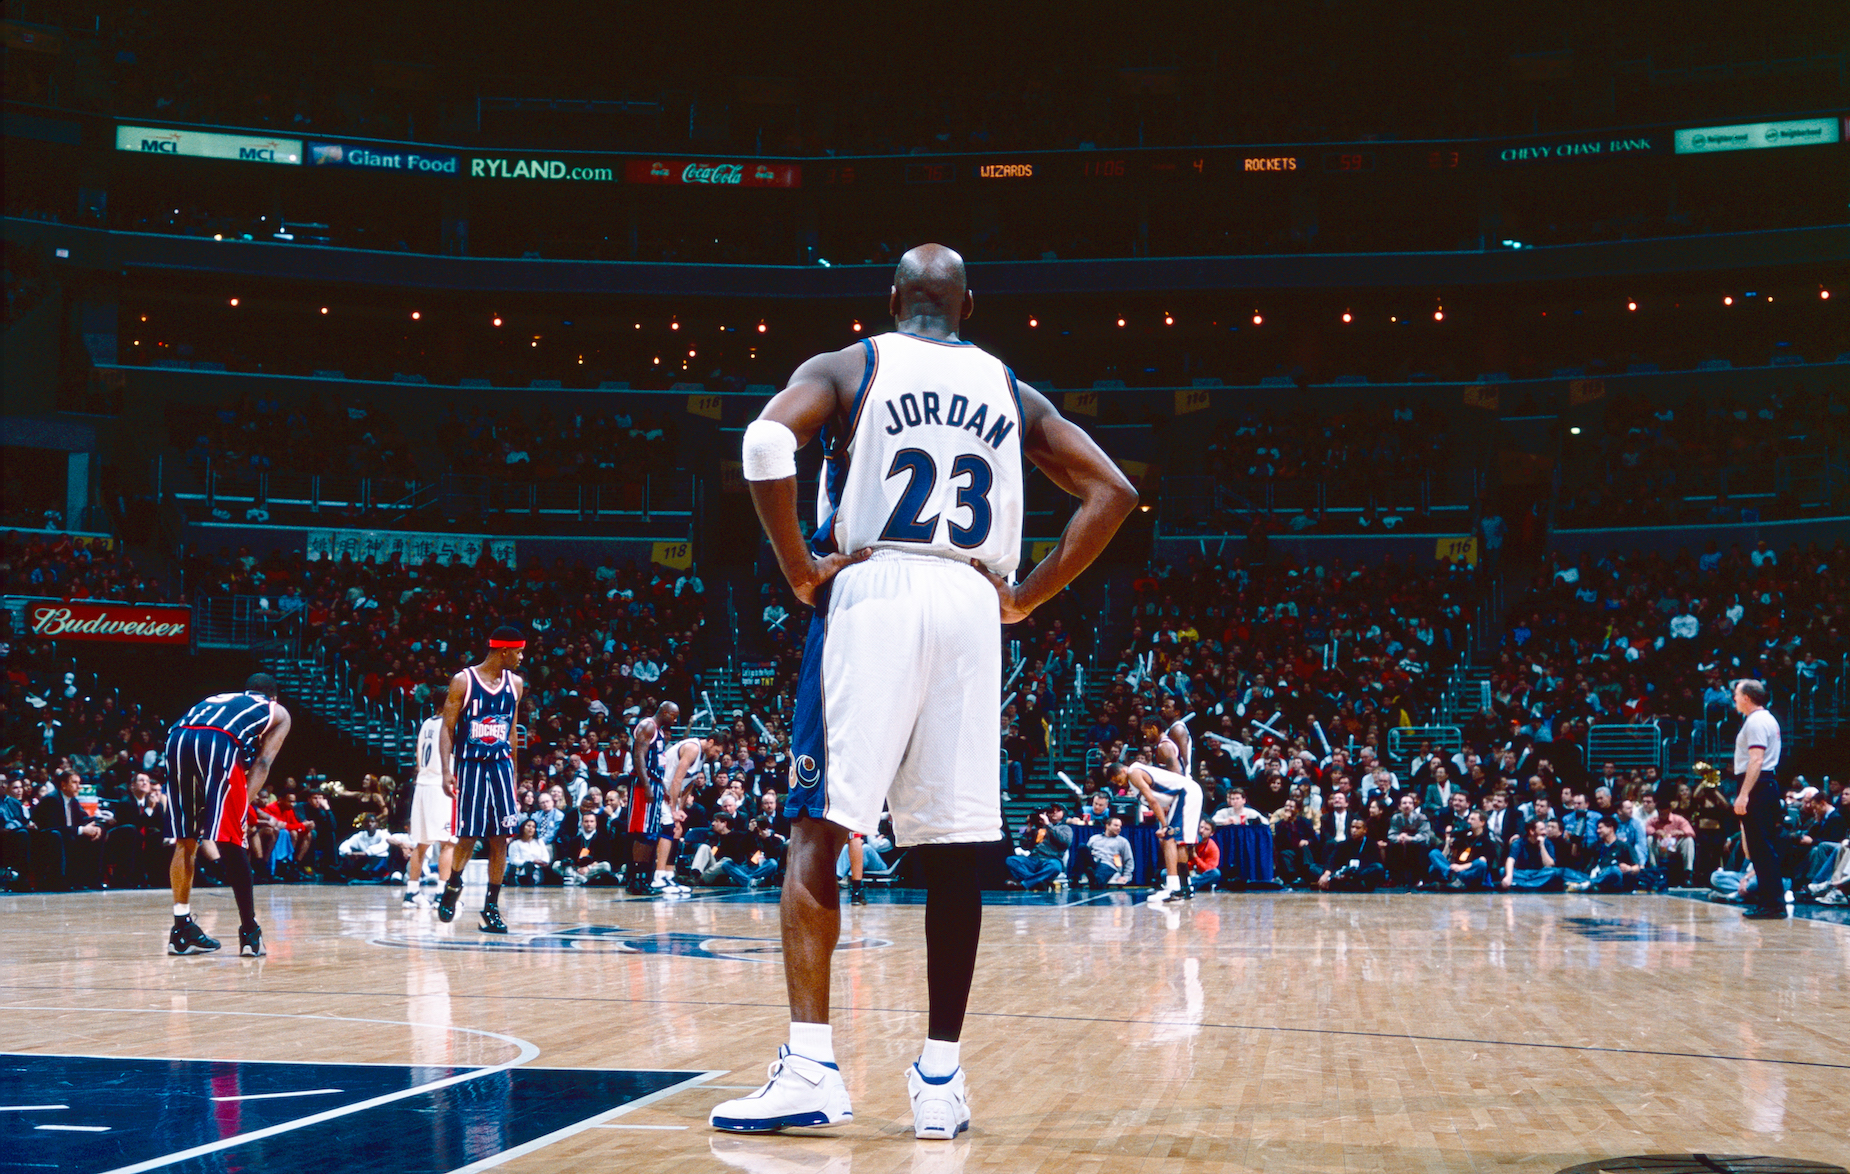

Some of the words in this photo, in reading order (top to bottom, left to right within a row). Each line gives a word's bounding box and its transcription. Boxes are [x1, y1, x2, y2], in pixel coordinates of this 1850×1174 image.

[140, 139, 178, 154] MCI
[239, 147, 275, 162] MCI
[1501, 146, 1551, 162] CHEVY
[1556, 141, 1603, 157] CHASE
[1610, 138, 1651, 152] BANK
[348, 150, 401, 169] Giant
[407, 155, 456, 173] Food
[471, 158, 613, 181] RYLAND.com
[980, 164, 1033, 178] WIZARDS
[1192, 158, 1204, 173] 4
[1244, 157, 1297, 172] ROCKETS
[885, 391, 1015, 450] JORDAN
[878, 447, 993, 549] 23
[664, 544, 687, 560] 118
[1449, 538, 1472, 555] 116
[32, 608, 185, 637] Budweiser
[471, 721, 506, 742] ROCKETS
